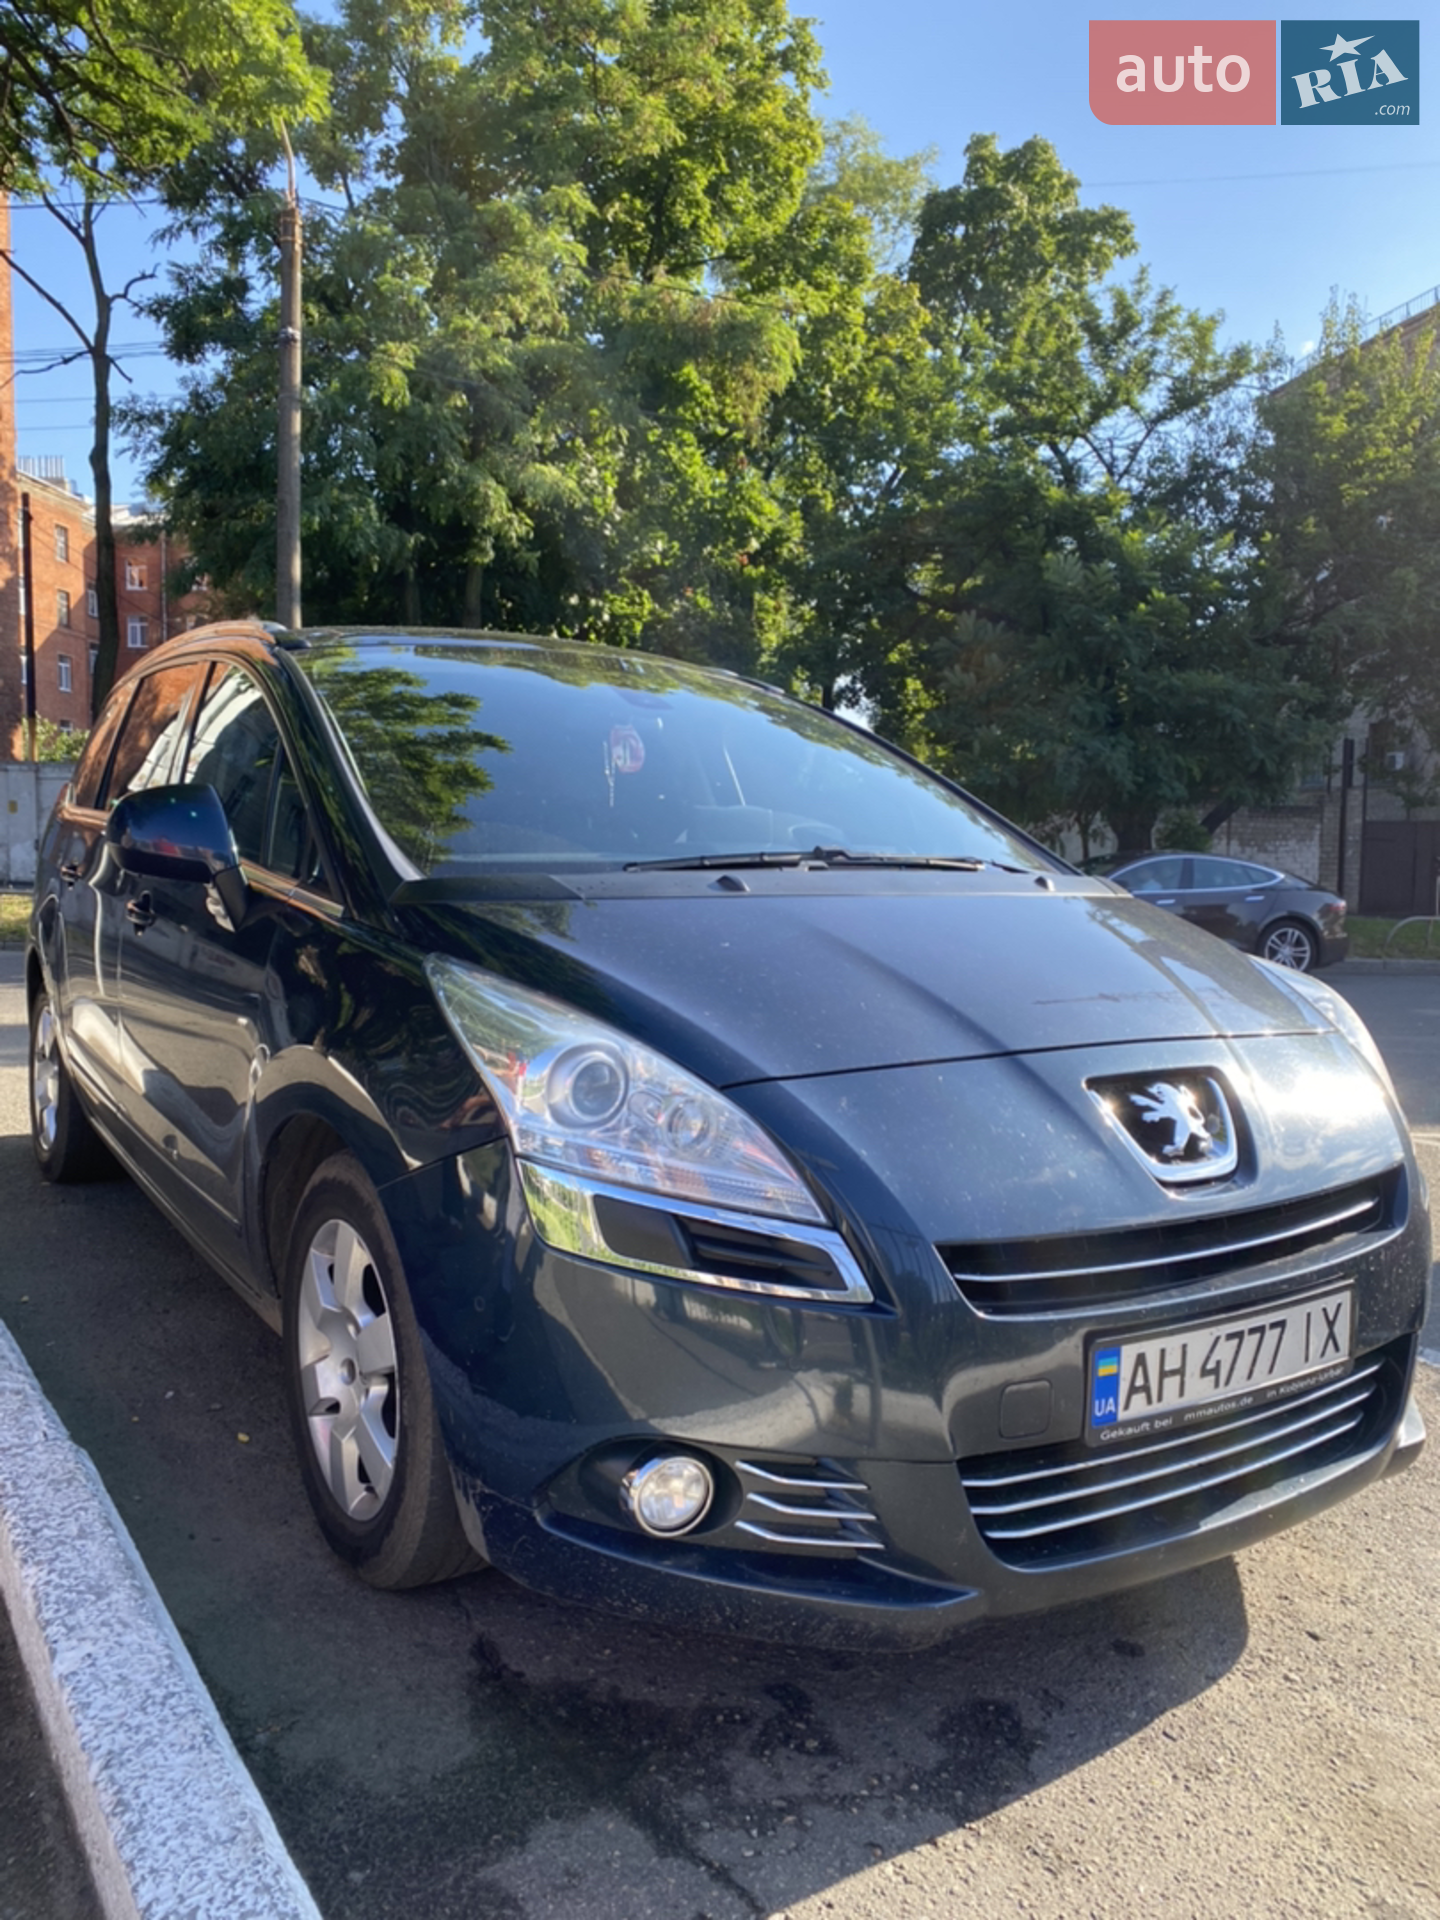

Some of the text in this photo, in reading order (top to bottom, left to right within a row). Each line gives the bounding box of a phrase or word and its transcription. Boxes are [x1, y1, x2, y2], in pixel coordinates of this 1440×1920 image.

[1123, 1302, 1343, 1412] AH 4777 IX
[1094, 1396, 1117, 1418] UA
[1100, 1421, 1150, 1441] Gekauft
[1154, 1416, 1173, 1429] bei
